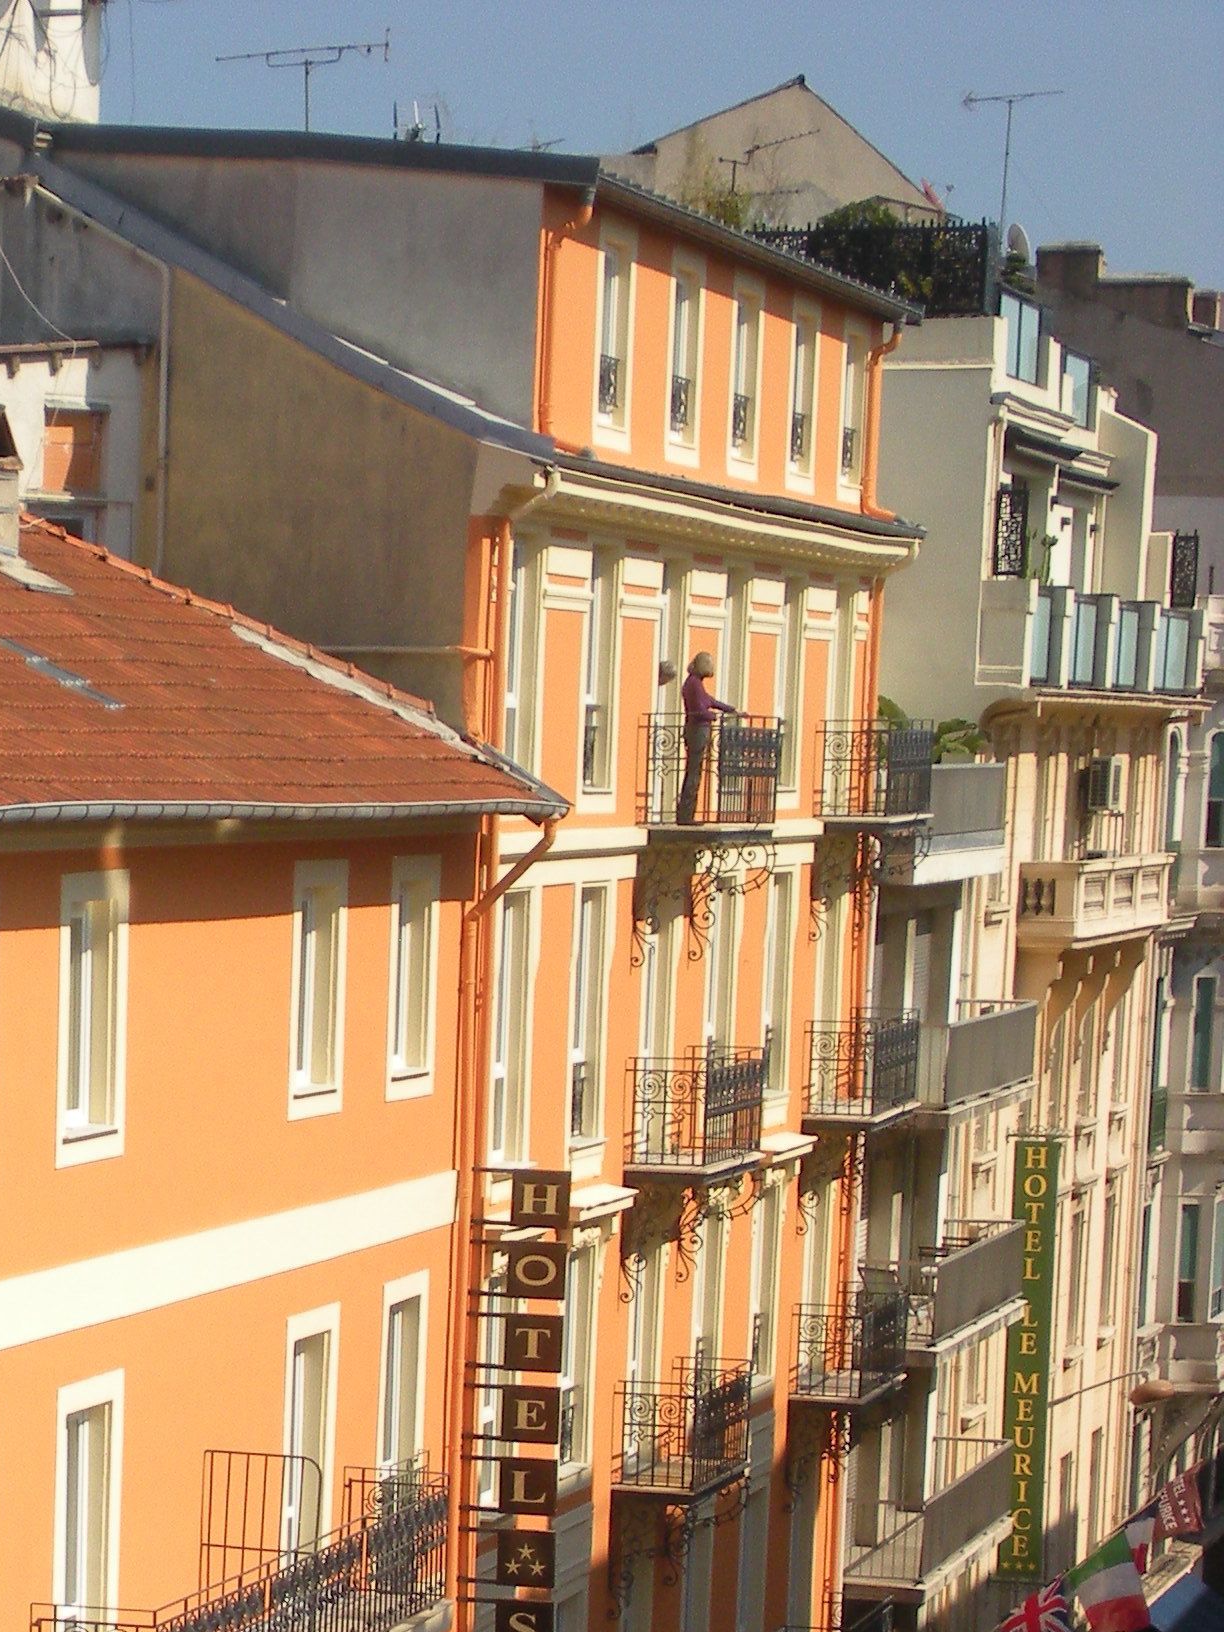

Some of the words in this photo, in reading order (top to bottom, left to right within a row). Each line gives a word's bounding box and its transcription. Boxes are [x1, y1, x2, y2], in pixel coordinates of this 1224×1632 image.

[1022, 1145, 1048, 1281] HOTEL
[509, 1182, 562, 1504] HOTEL
[1019, 1304, 1039, 1355] LE
[1011, 1371, 1040, 1557] MEURICE
